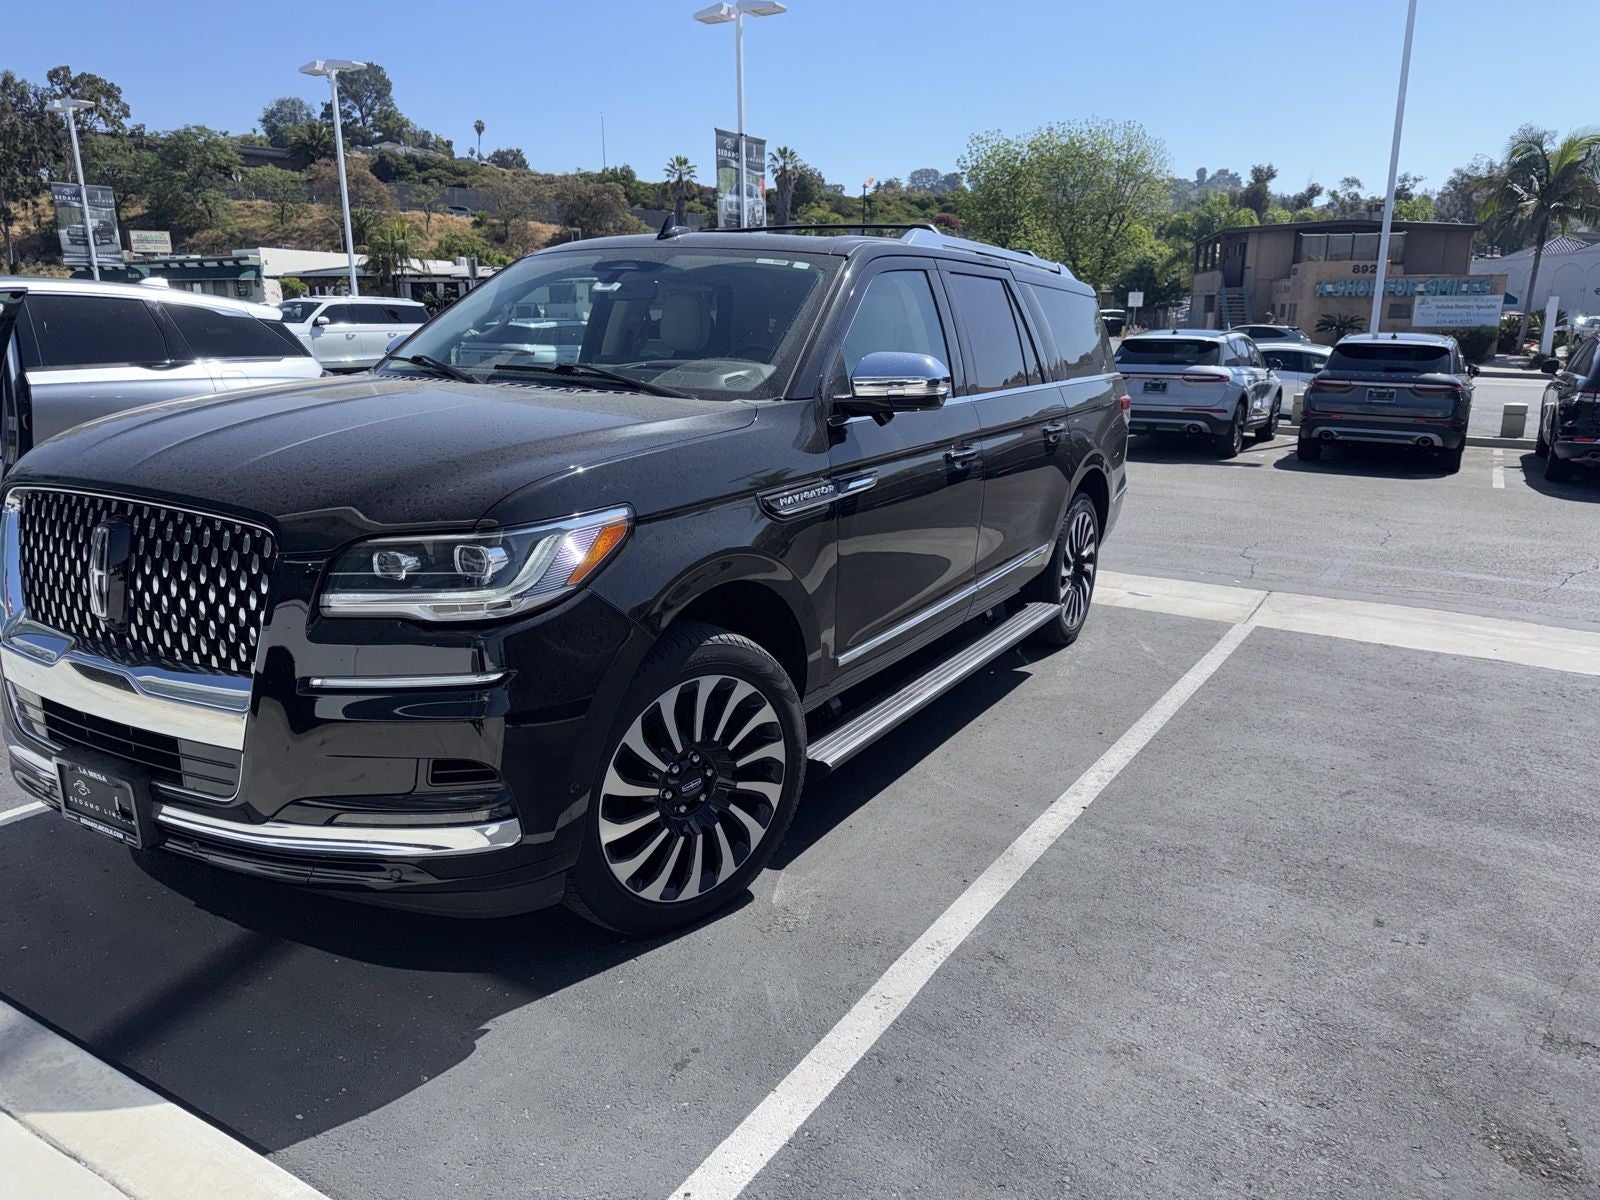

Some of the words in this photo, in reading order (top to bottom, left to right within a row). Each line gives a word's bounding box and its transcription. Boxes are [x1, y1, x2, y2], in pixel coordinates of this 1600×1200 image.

[717, 148, 739, 159] SEDANO
[54, 194, 81, 202] SEDANO
[1315, 281, 1328, 297] A
[1383, 278, 1421, 297] FOR
[1423, 278, 1493, 297] SMILES
[779, 485, 835, 506] NAVIGATOR
[77, 766, 89, 776] LA
[87, 770, 108, 783] MESA
[69, 795, 100, 811] SEDANO
